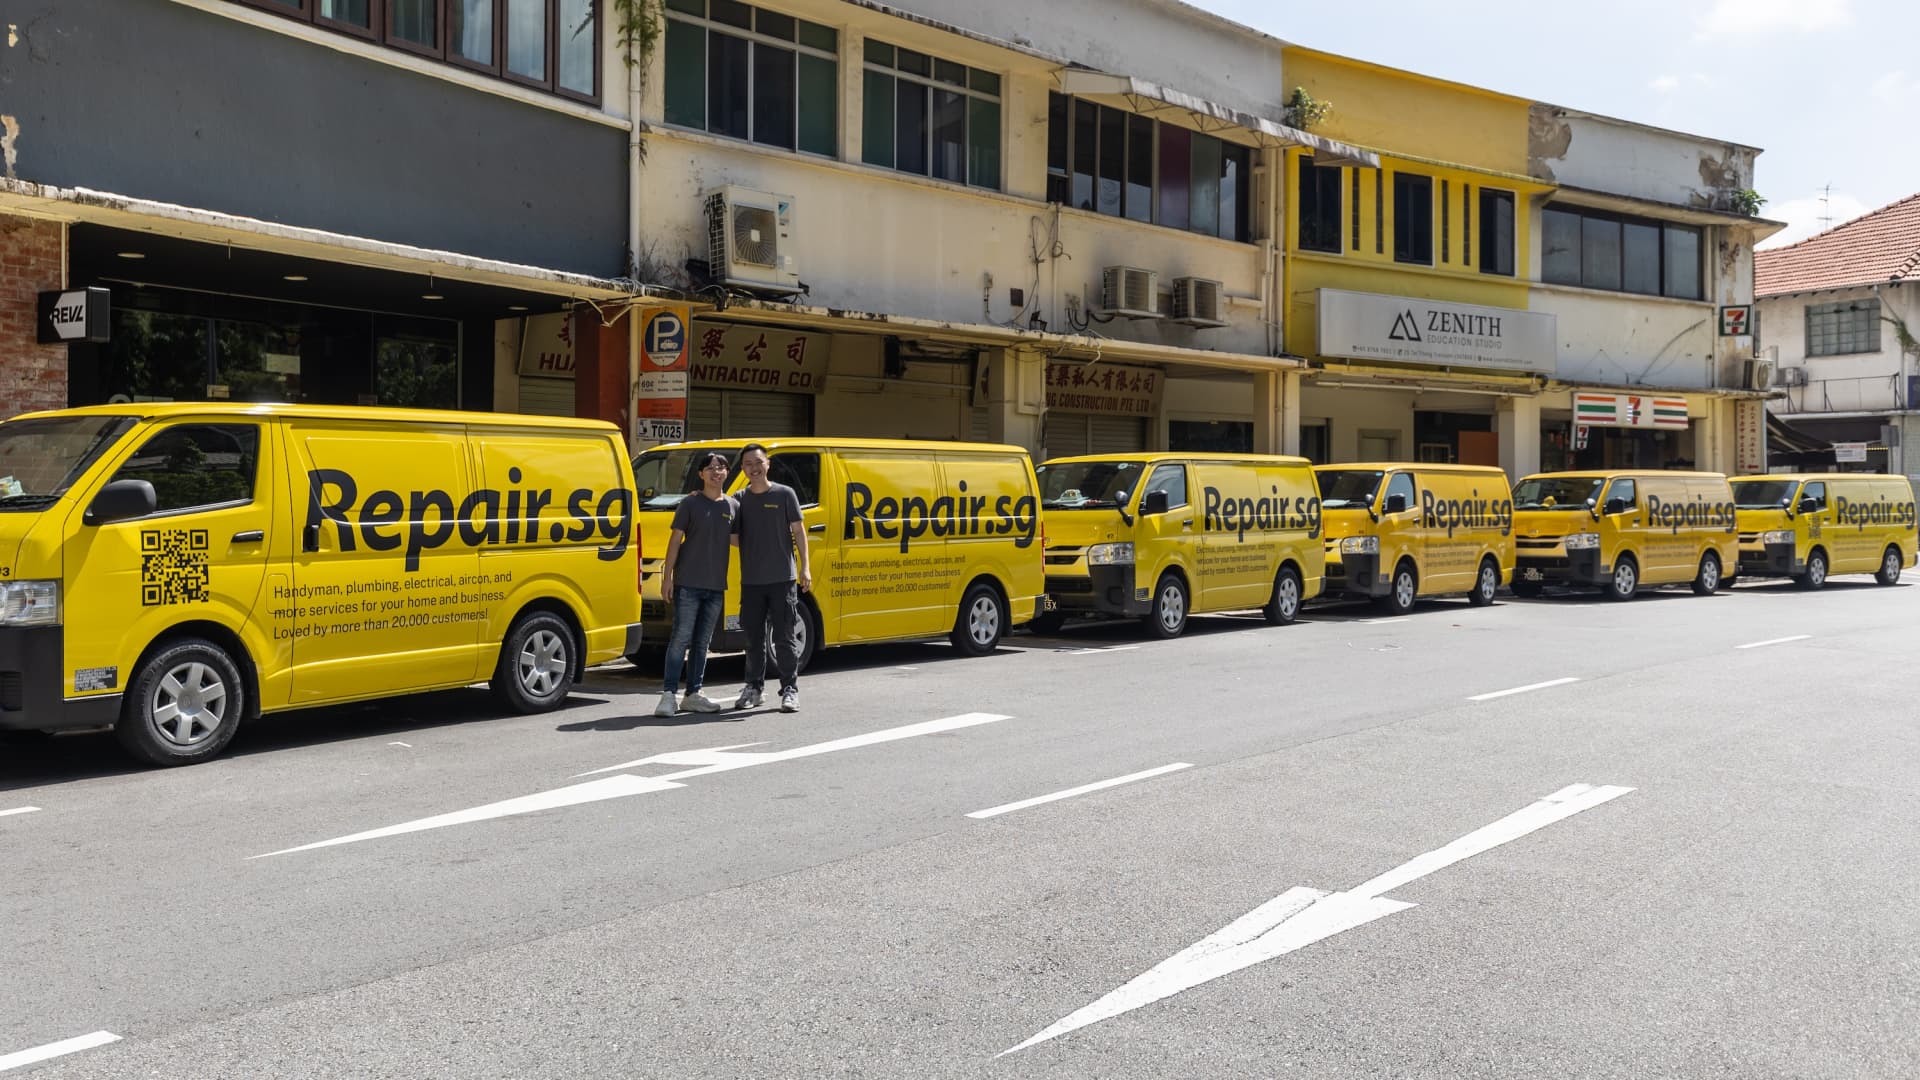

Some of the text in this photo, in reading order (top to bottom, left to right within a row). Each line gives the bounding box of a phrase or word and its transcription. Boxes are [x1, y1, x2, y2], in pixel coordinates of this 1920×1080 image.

[653, 316, 681, 353] P
[1427, 310, 1502, 337] ZENITH
[1427, 334, 1502, 349] EDUCATION STUDIO
[1058, 393, 1118, 411] CONSTRUCTION
[1120, 398, 1132, 412] PTE
[651, 425, 682, 439] T0025
[303, 467, 634, 572] Repair.sg
[844, 480, 1036, 553] Repair.sg
[1204, 485, 1321, 543] Repair.sg
[1422, 488, 1512, 538] Repair.sg
[1648, 494, 1735, 535] Repair.sg
[1837, 494, 1916, 532] Repair.sg
[274, 571, 512, 599] Handyman, plumbing, electrical, aircon, and
[831, 575, 848, 584] more
[850, 573, 878, 583] services
[879, 572, 888, 581] for
[889, 572, 904, 582] your
[904, 570, 921, 579] home
[922, 569, 934, 578] and
[831, 588, 851, 598] Loved
[852, 587, 860, 596] by
[861, 587, 878, 595] more
[879, 585, 894, 594] than
[274, 608, 306, 619] more
[309, 602, 358, 616] services
[361, 600, 377, 612] for
[380, 600, 405, 613] your
[407, 596, 437, 608] home
[440, 592, 458, 605] and
[274, 608, 488, 640] Loved by more than 20,000 customers!
